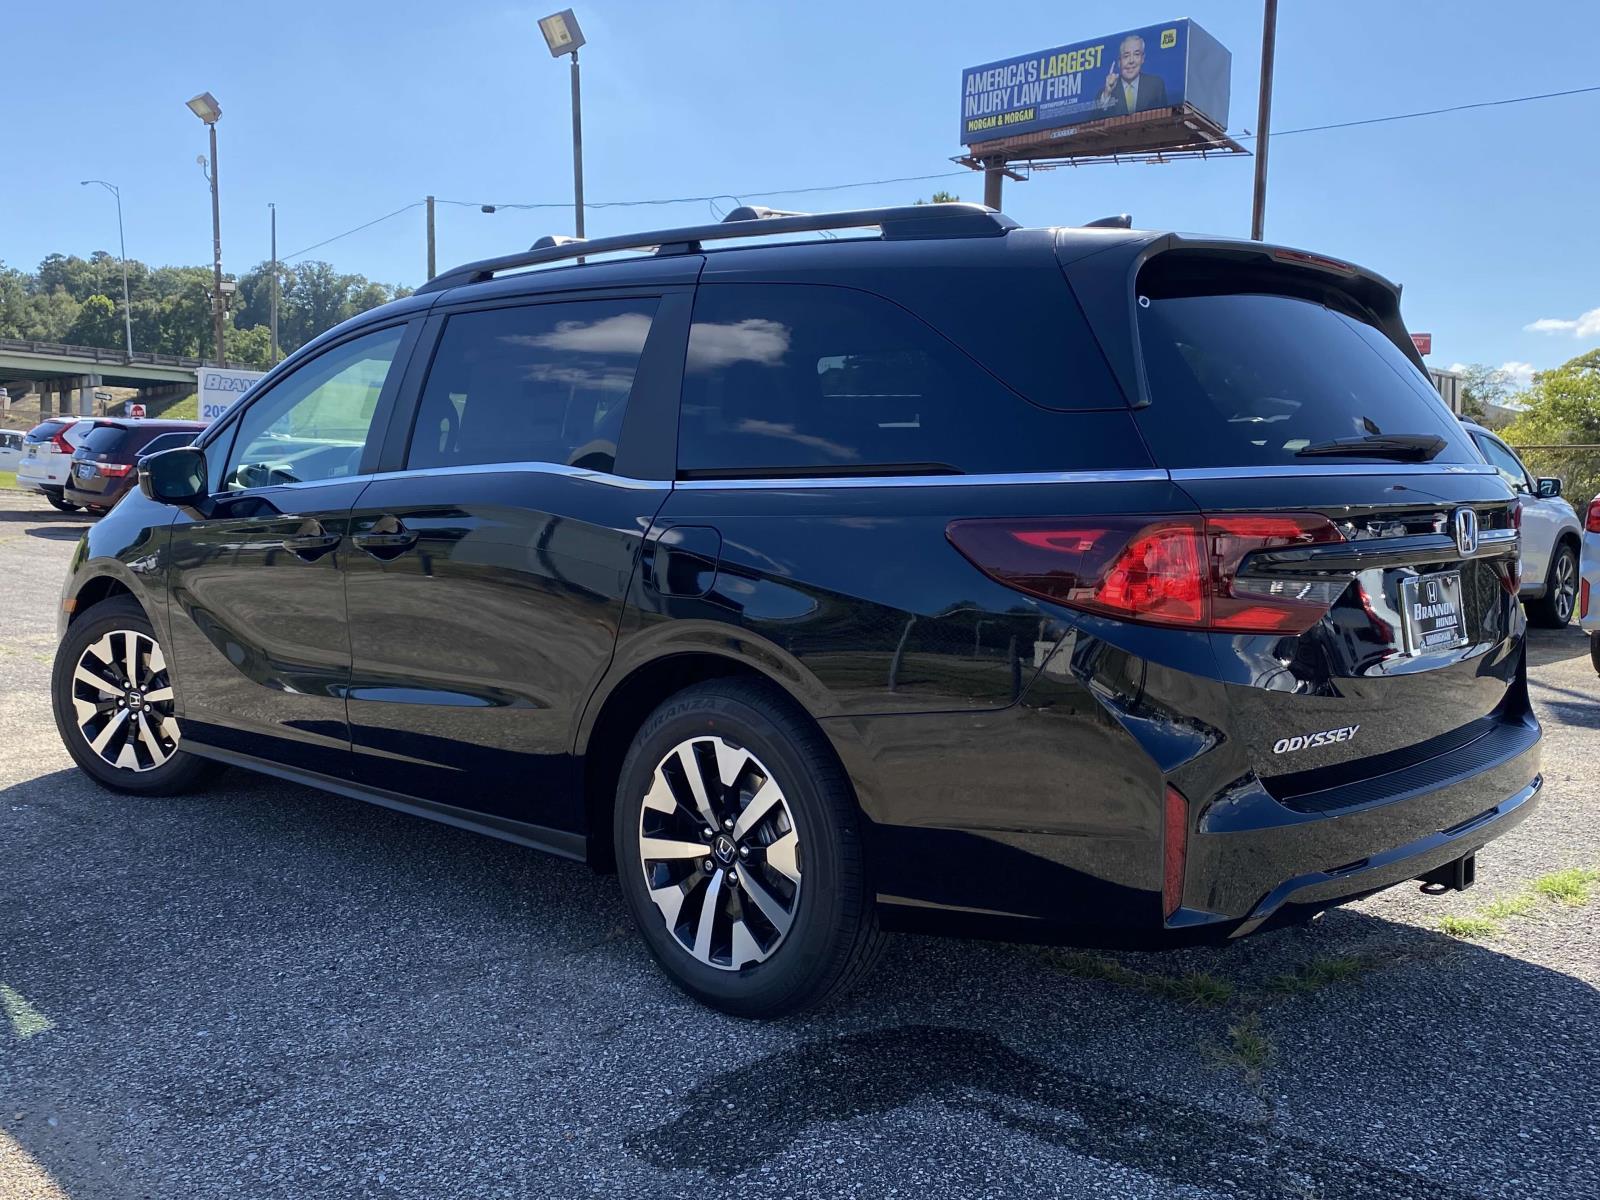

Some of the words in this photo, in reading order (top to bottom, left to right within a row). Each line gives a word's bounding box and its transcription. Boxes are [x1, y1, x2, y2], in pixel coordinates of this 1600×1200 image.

[966, 60, 1038, 96] AMERICA'S
[1040, 45, 1105, 80] LARGEST
[965, 87, 1012, 117] INJURY
[1013, 81, 1044, 108] LAW
[1047, 72, 1082, 101] FIRM
[968, 116, 997, 132] MORGAN
[997, 114, 1004, 126] &
[1004, 108, 1034, 124] MORGAN
[204, 374, 258, 392] BRAN
[1413, 602, 1456, 621] BRANNON
[1435, 615, 1458, 628] HONDA
[1273, 724, 1360, 754] ODYSSEY
